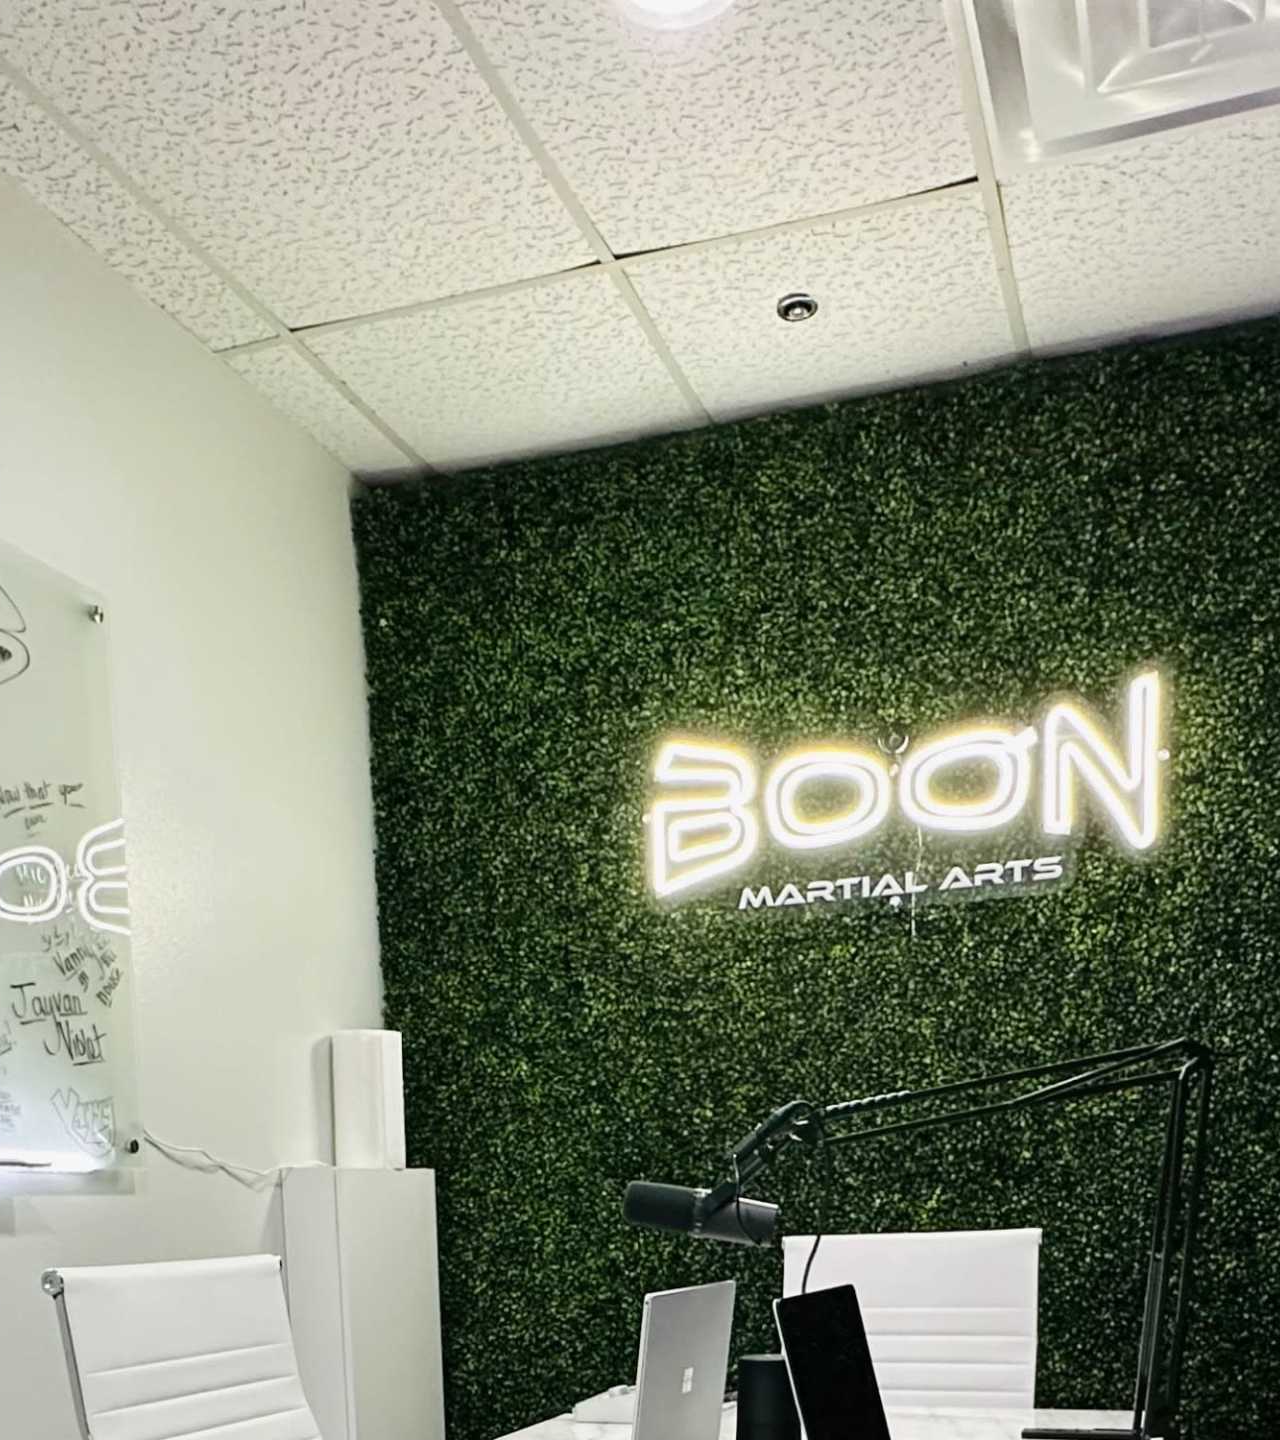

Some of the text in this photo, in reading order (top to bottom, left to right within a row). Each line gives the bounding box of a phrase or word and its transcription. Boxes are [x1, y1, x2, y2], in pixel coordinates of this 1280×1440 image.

[650, 670, 1160, 898] BOON
[738, 855, 1064, 910] MARTIAL ARTS
